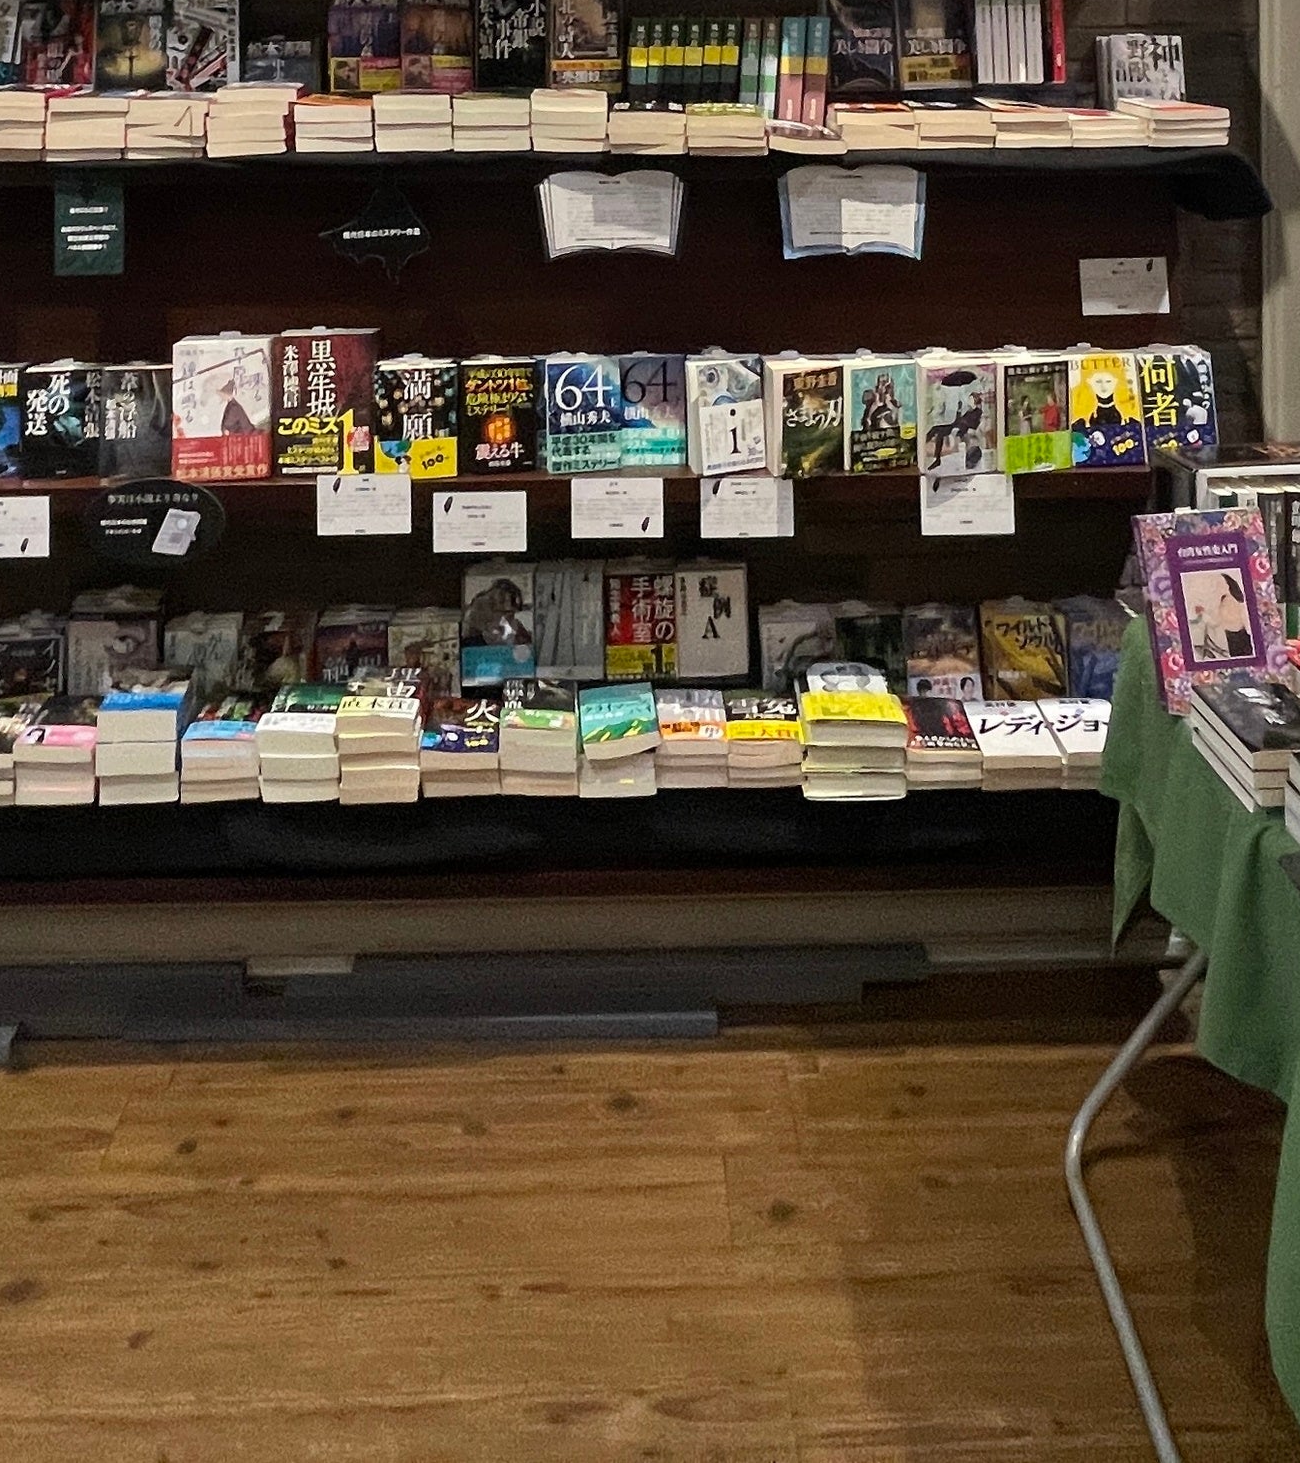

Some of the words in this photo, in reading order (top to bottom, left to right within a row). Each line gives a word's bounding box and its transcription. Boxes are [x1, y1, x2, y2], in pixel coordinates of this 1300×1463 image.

[305, 338, 337, 418] 黒牢城
[554, 363, 613, 412] 64
[620, 359, 679, 406] 64
[1069, 356, 1132, 372] BUTTER
[24, 388, 50, 437] 発送
[47, 373, 72, 416] 死の
[402, 370, 436, 441] 満願
[1139, 354, 1180, 428] 何者
[277, 415, 340, 436] このミス
[337, 408, 361, 476] 1
[474, 441, 526, 460] 震える牛
[629, 575, 653, 643] 手術室
[653, 574, 675, 640] 螺旋の
